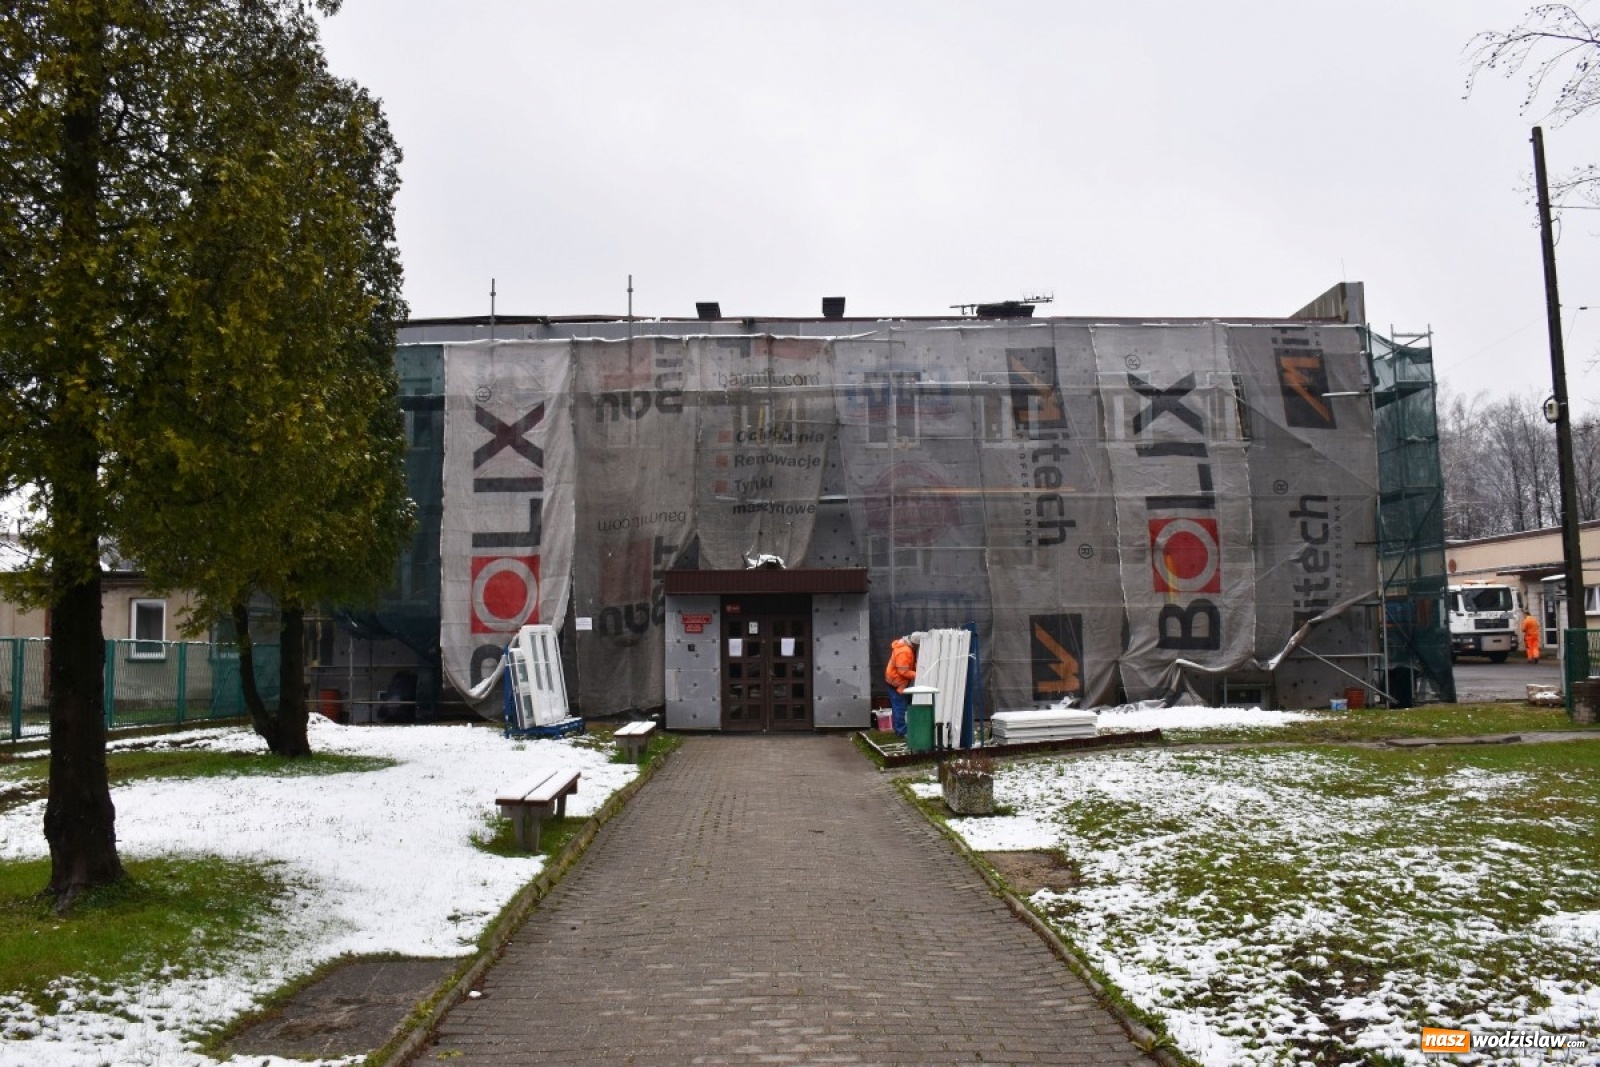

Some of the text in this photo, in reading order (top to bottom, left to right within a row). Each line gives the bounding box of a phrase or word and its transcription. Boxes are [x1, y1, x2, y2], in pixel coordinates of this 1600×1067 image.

[735, 453, 821, 469] Renowacje
[735, 476, 773, 494] Tynki
[1127, 371, 1220, 649] BOLIX
